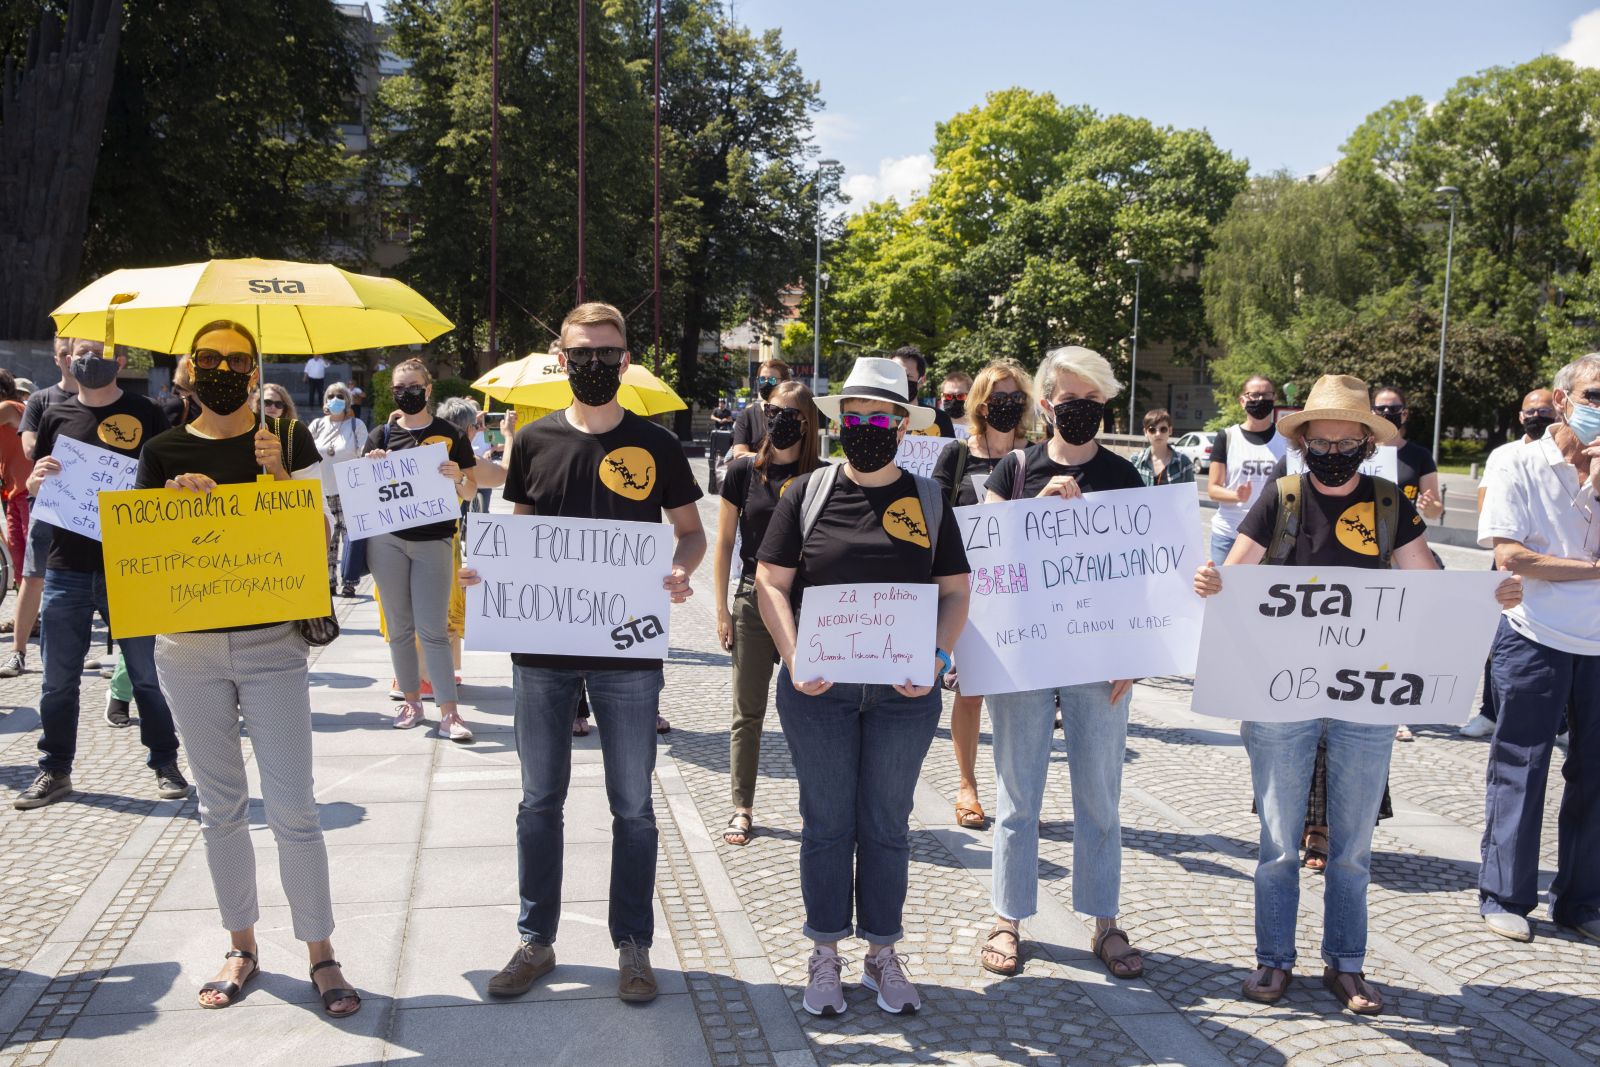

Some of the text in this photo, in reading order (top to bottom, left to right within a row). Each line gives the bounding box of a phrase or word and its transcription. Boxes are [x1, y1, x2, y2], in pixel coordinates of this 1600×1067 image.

[248, 277, 306, 294] sta
[902, 440, 939, 460] DOBR
[372, 460, 397, 483] NISI
[400, 457, 420, 478] NA
[112, 489, 316, 525] nacionalna AGENCIJA
[378, 480, 414, 503] sta
[352, 497, 452, 532] TE NI NIKJER
[966, 504, 1152, 551] ZA AGENCIJO
[192, 529, 226, 546] ali
[473, 520, 656, 567] ZA POLITIČNO
[1042, 544, 1186, 590] DRŽAVLJANOV
[170, 574, 306, 603] MAGNETOGRAMOV
[481, 580, 626, 627] NEODVISNO
[1258, 575, 1353, 618] sta
[1051, 598, 1093, 613] in NE
[610, 614, 665, 651] sta
[996, 615, 1172, 648] NEKAJ ČLANOV VLADE
[1318, 625, 1367, 648] INU
